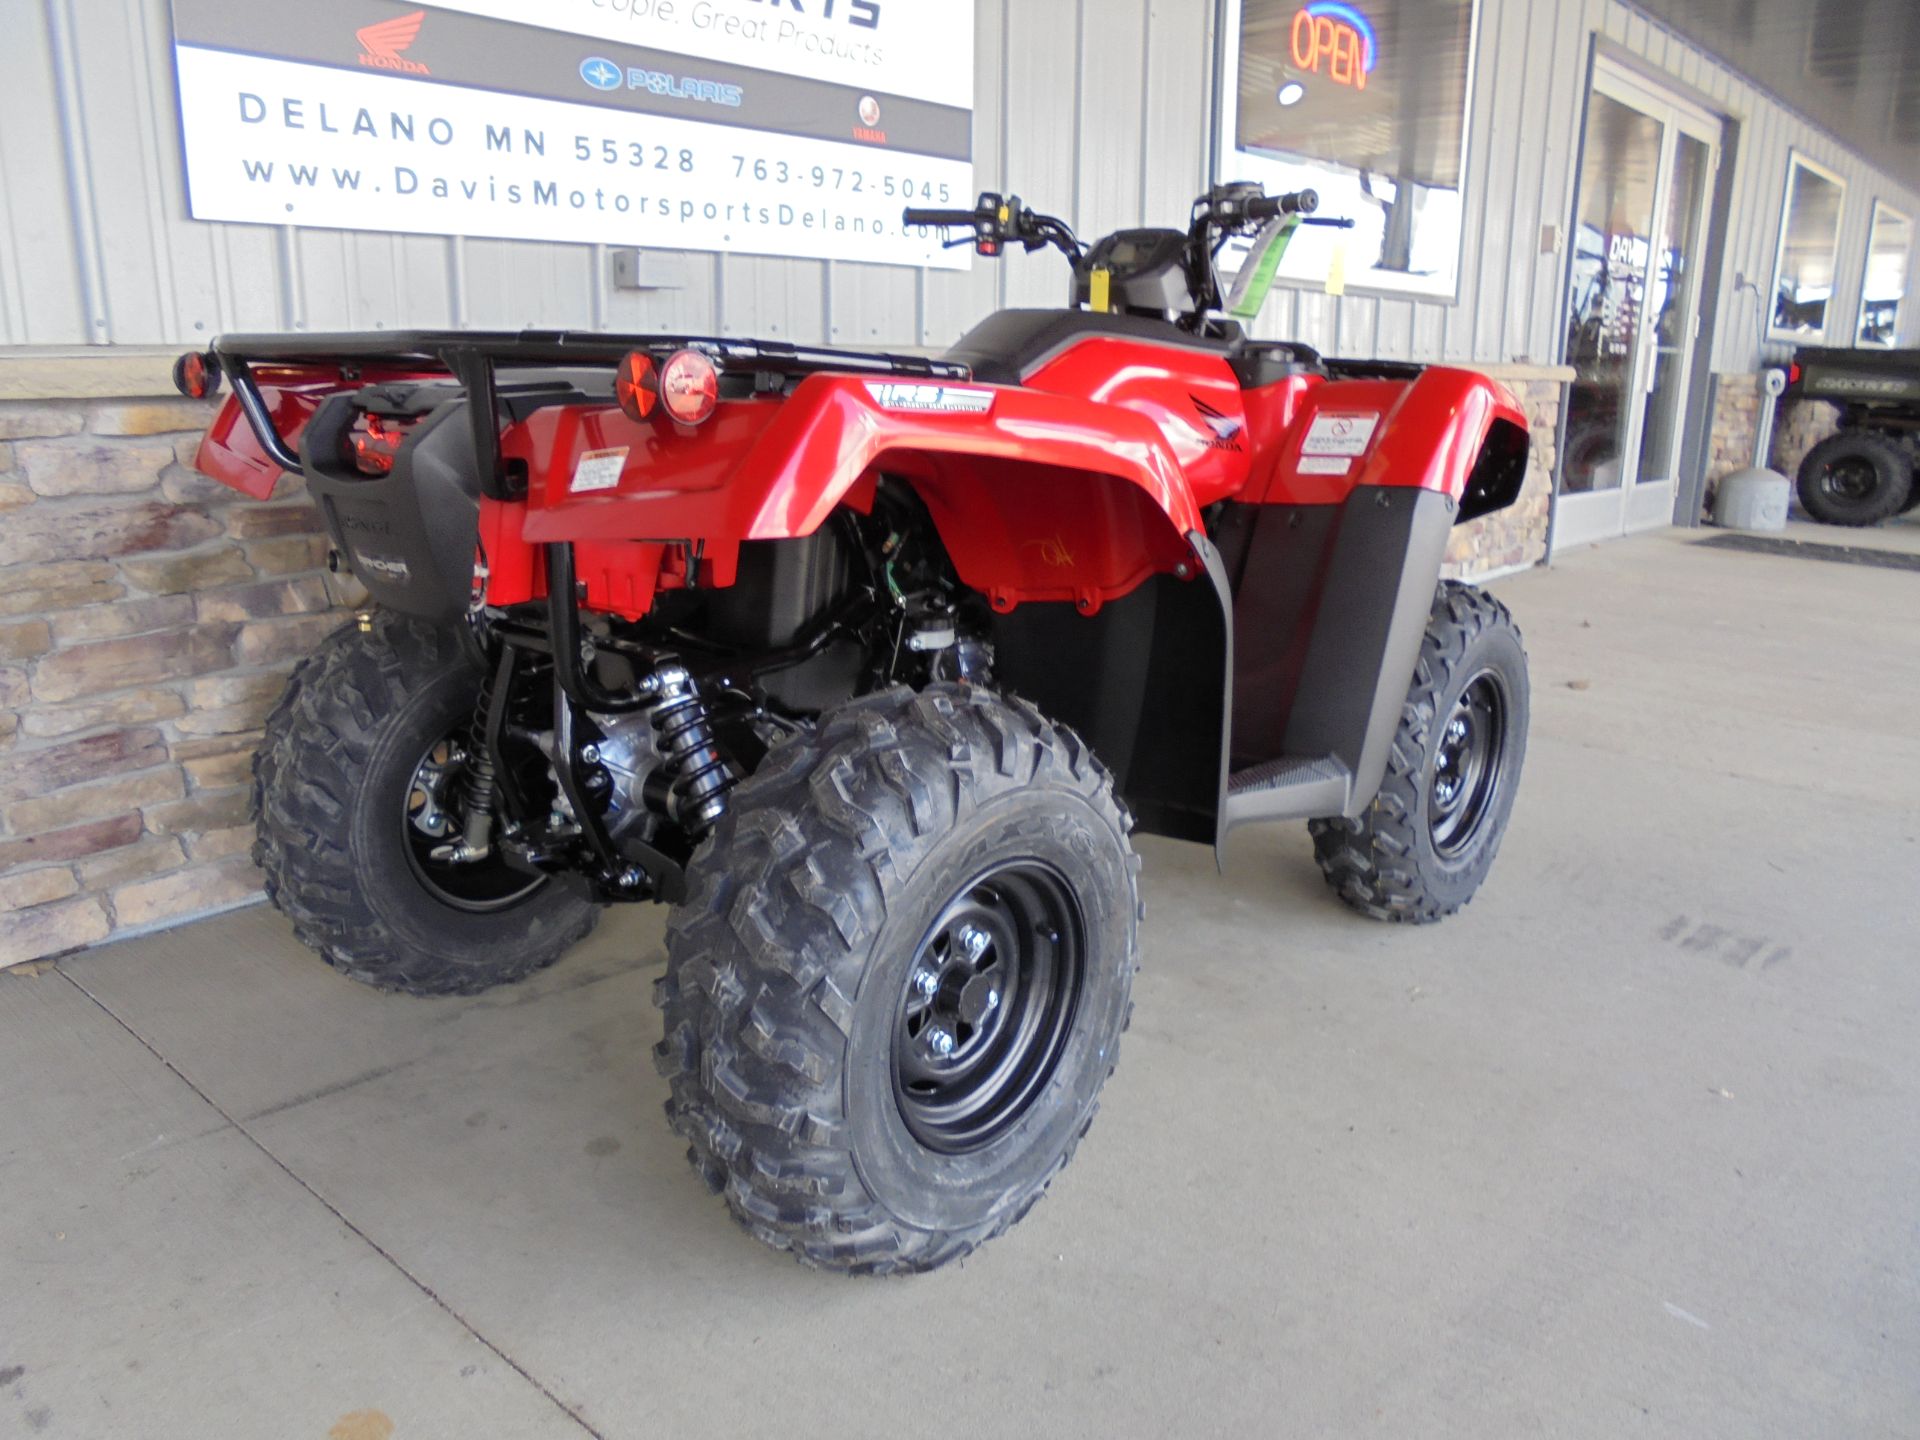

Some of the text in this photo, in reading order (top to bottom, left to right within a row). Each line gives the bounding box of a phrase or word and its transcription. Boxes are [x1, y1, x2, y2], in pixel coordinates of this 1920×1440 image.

[357, 53, 431, 75] HONDA
[691, 3, 768, 42] Great
[777, 19, 884, 66] Products
[1291, 9, 1368, 90] OPEN
[627, 67, 743, 107] POLARIS
[238, 92, 950, 203] DELANO MN 55328 763-972-5045
[242, 159, 950, 244] www.DavisMotorsportsDelano.com
